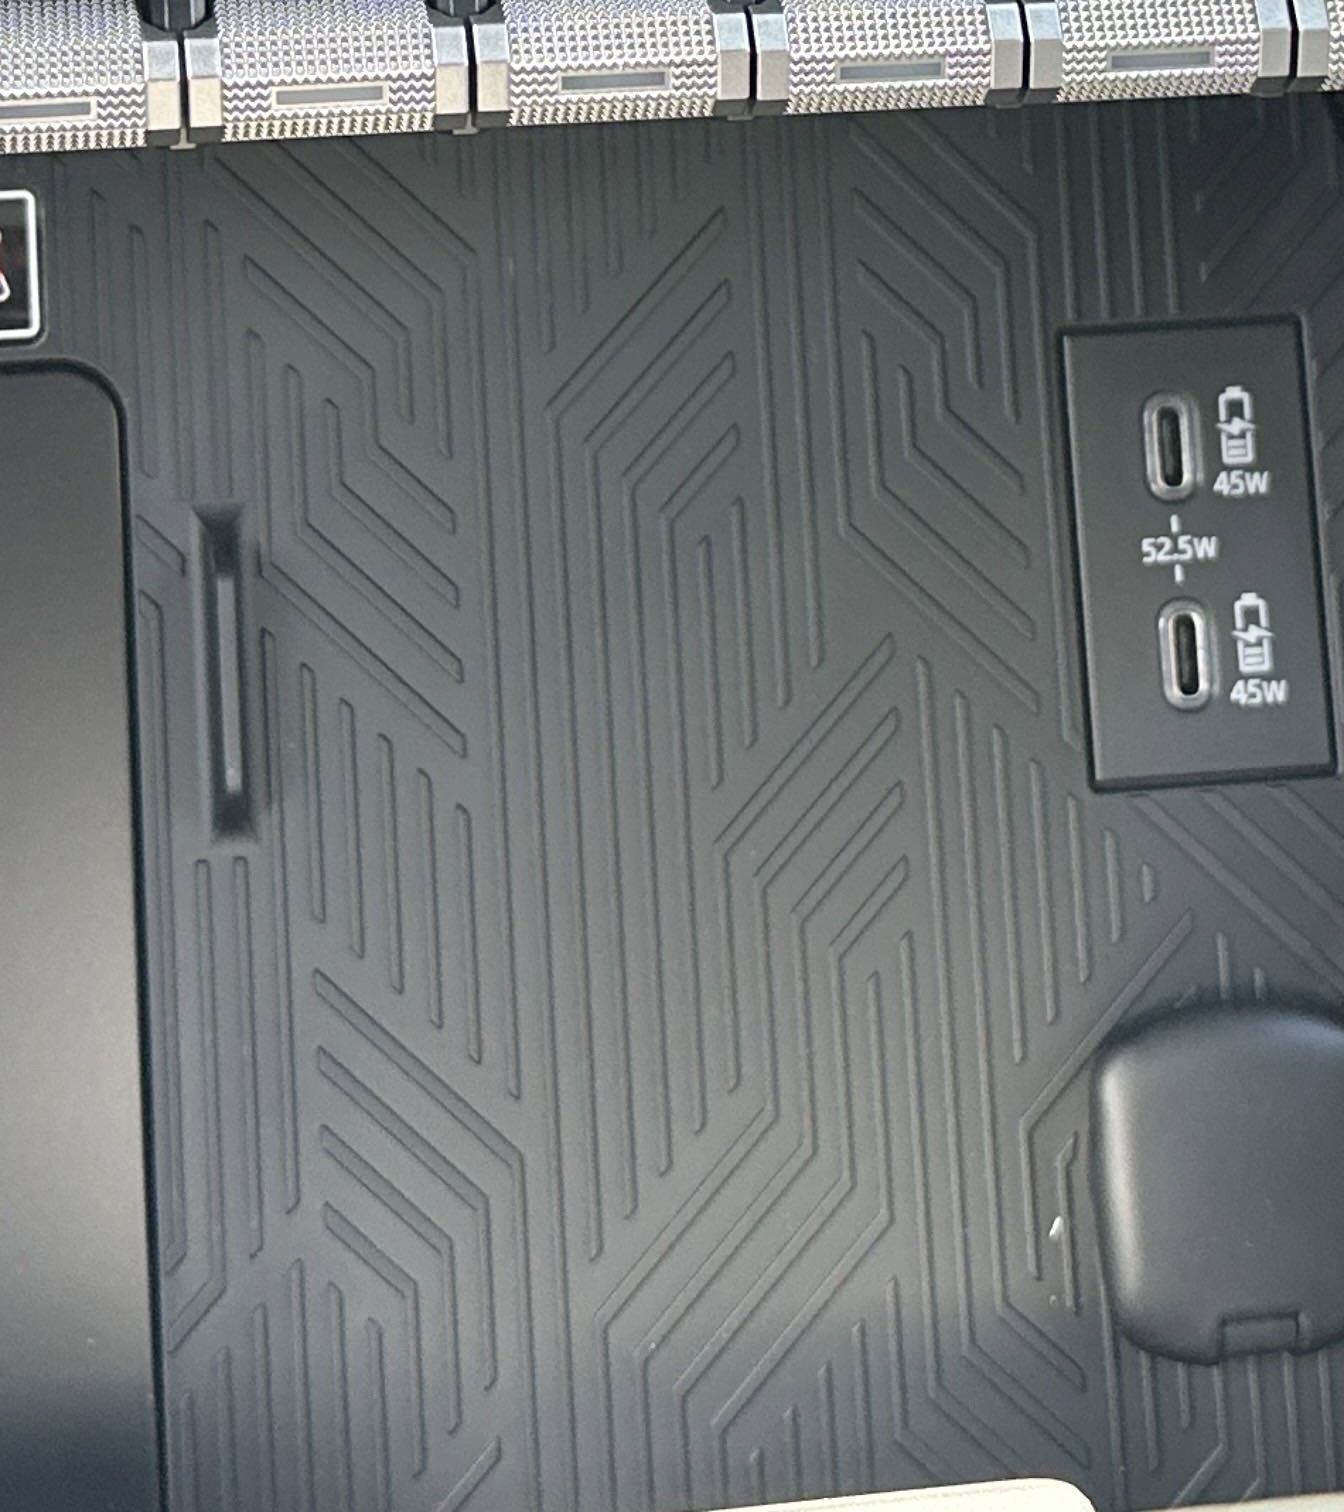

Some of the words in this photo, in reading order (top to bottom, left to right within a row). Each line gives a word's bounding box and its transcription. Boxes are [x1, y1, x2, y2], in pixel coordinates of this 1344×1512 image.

[1213, 471, 1269, 496] 45W
[1141, 536, 1218, 563] 52.5W
[1230, 679, 1287, 705] 45W
